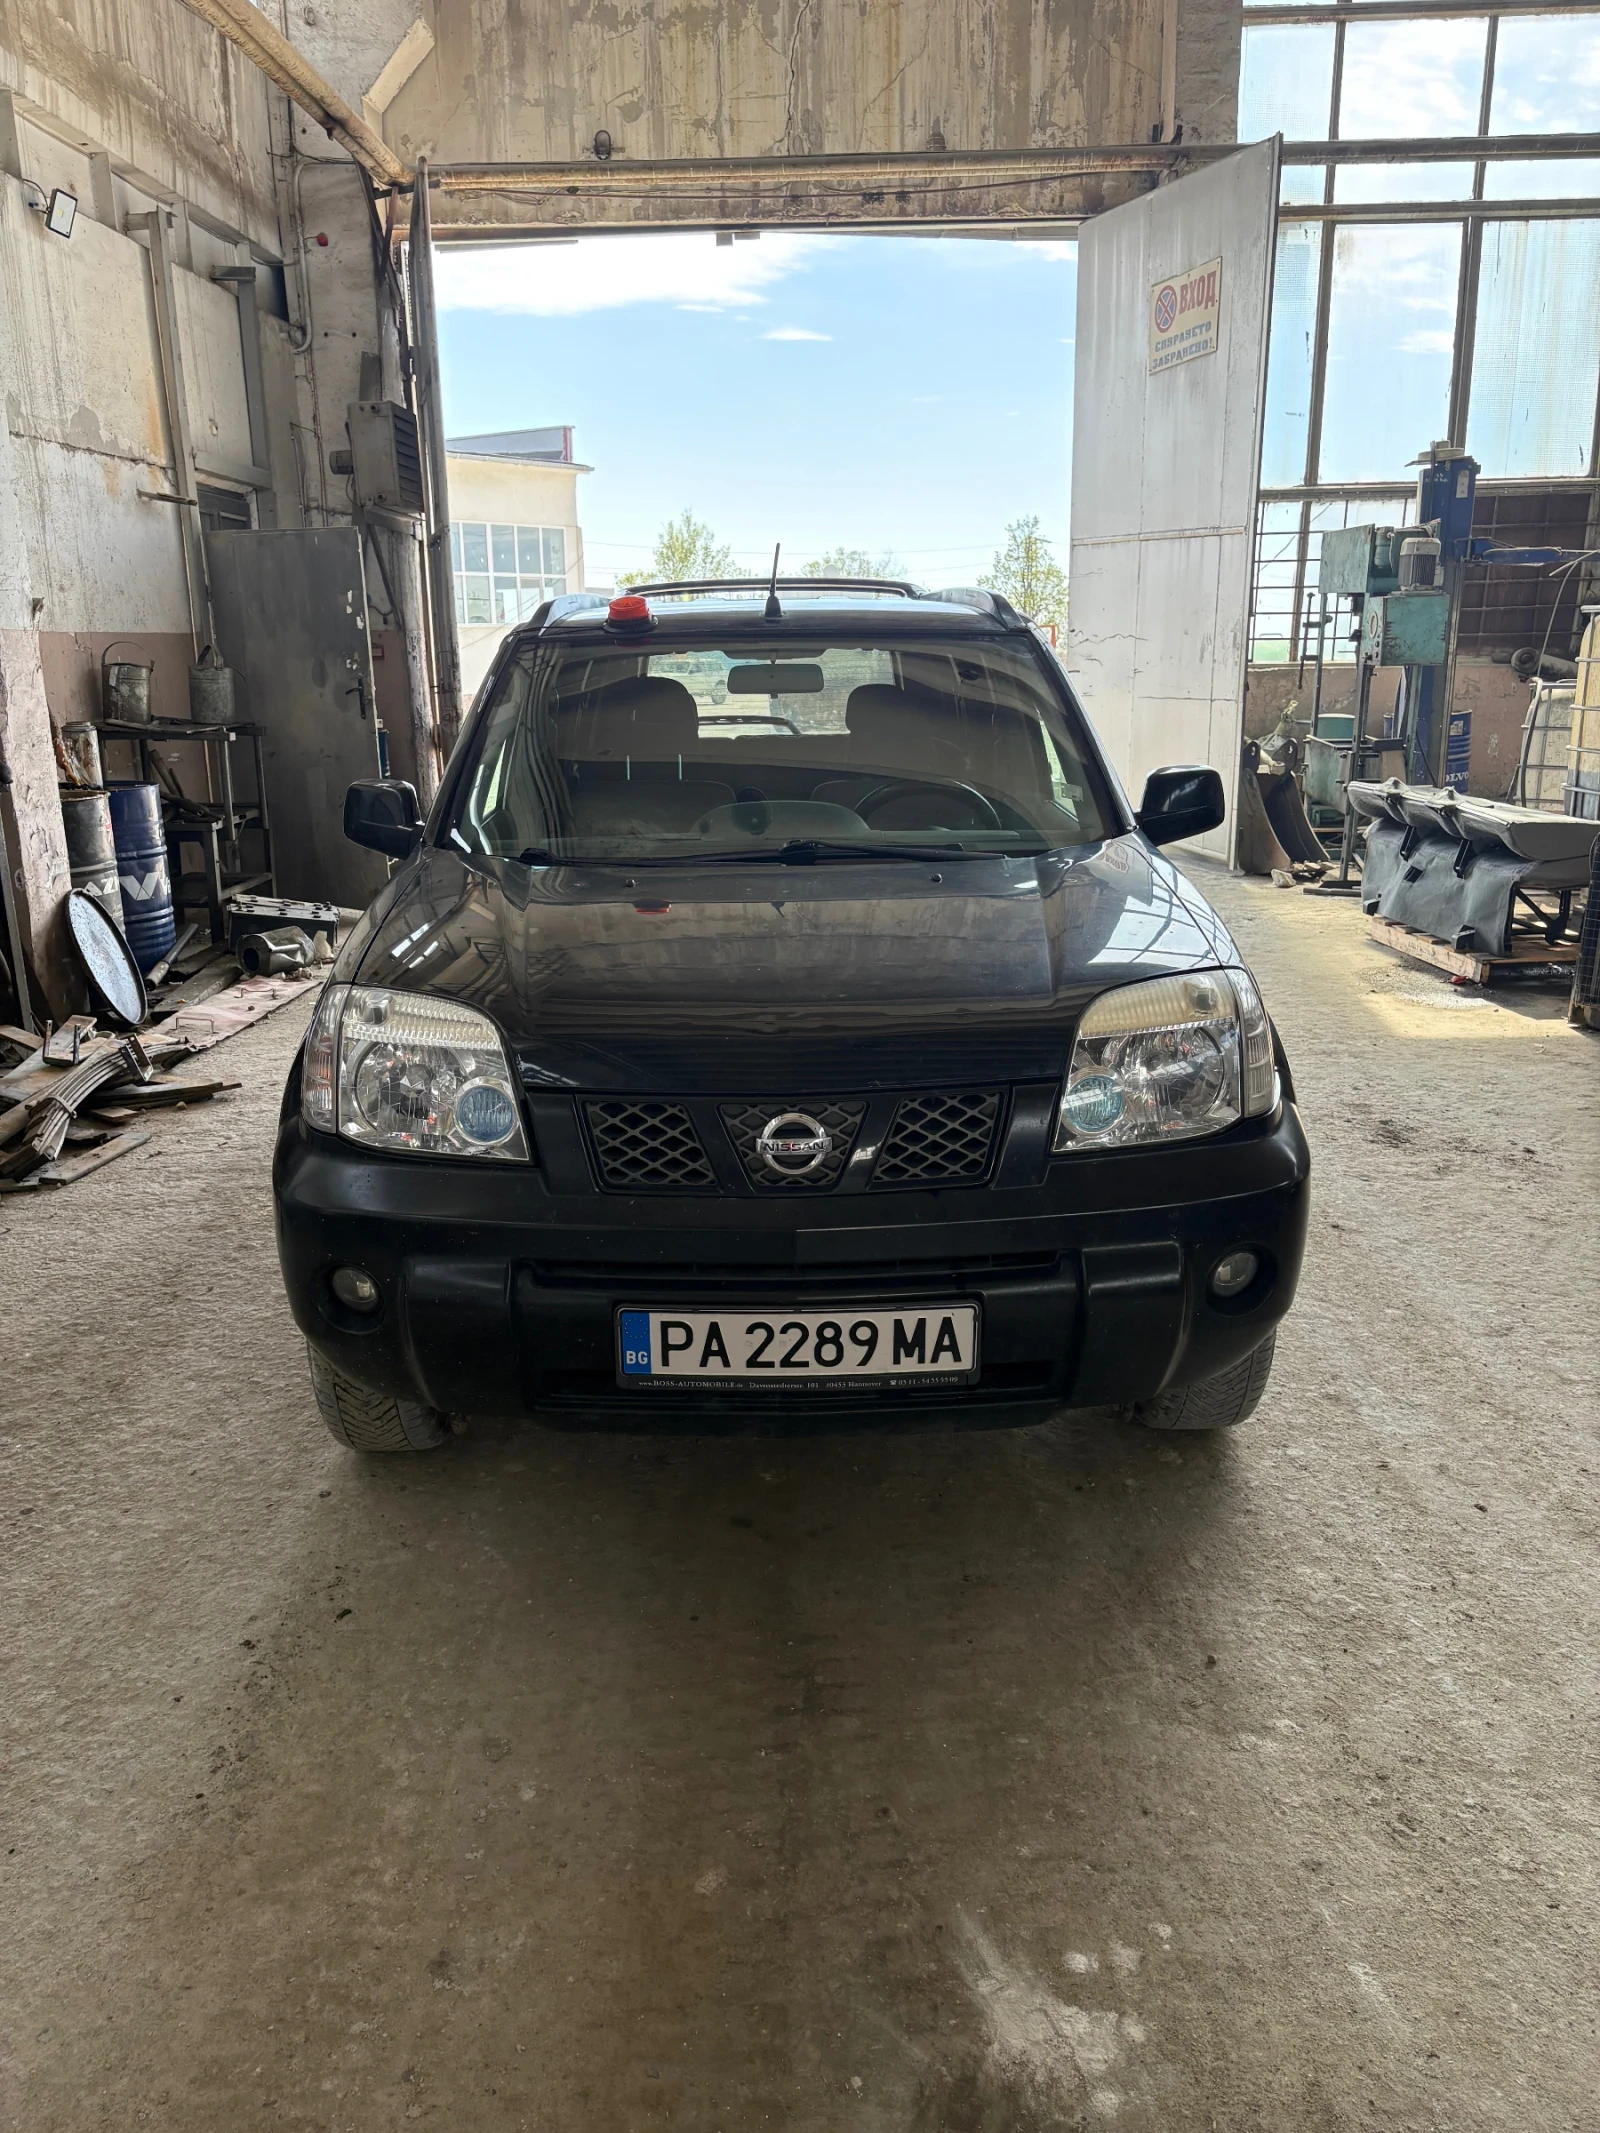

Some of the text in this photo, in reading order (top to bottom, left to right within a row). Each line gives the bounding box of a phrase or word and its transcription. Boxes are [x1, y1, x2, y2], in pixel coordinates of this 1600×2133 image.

[1179, 270, 1217, 315] ВХОД
[763, 1141, 824, 1152] NISSAN
[626, 1350, 648, 1365] BG
[660, 1316, 962, 1369] PA 2289 MA
